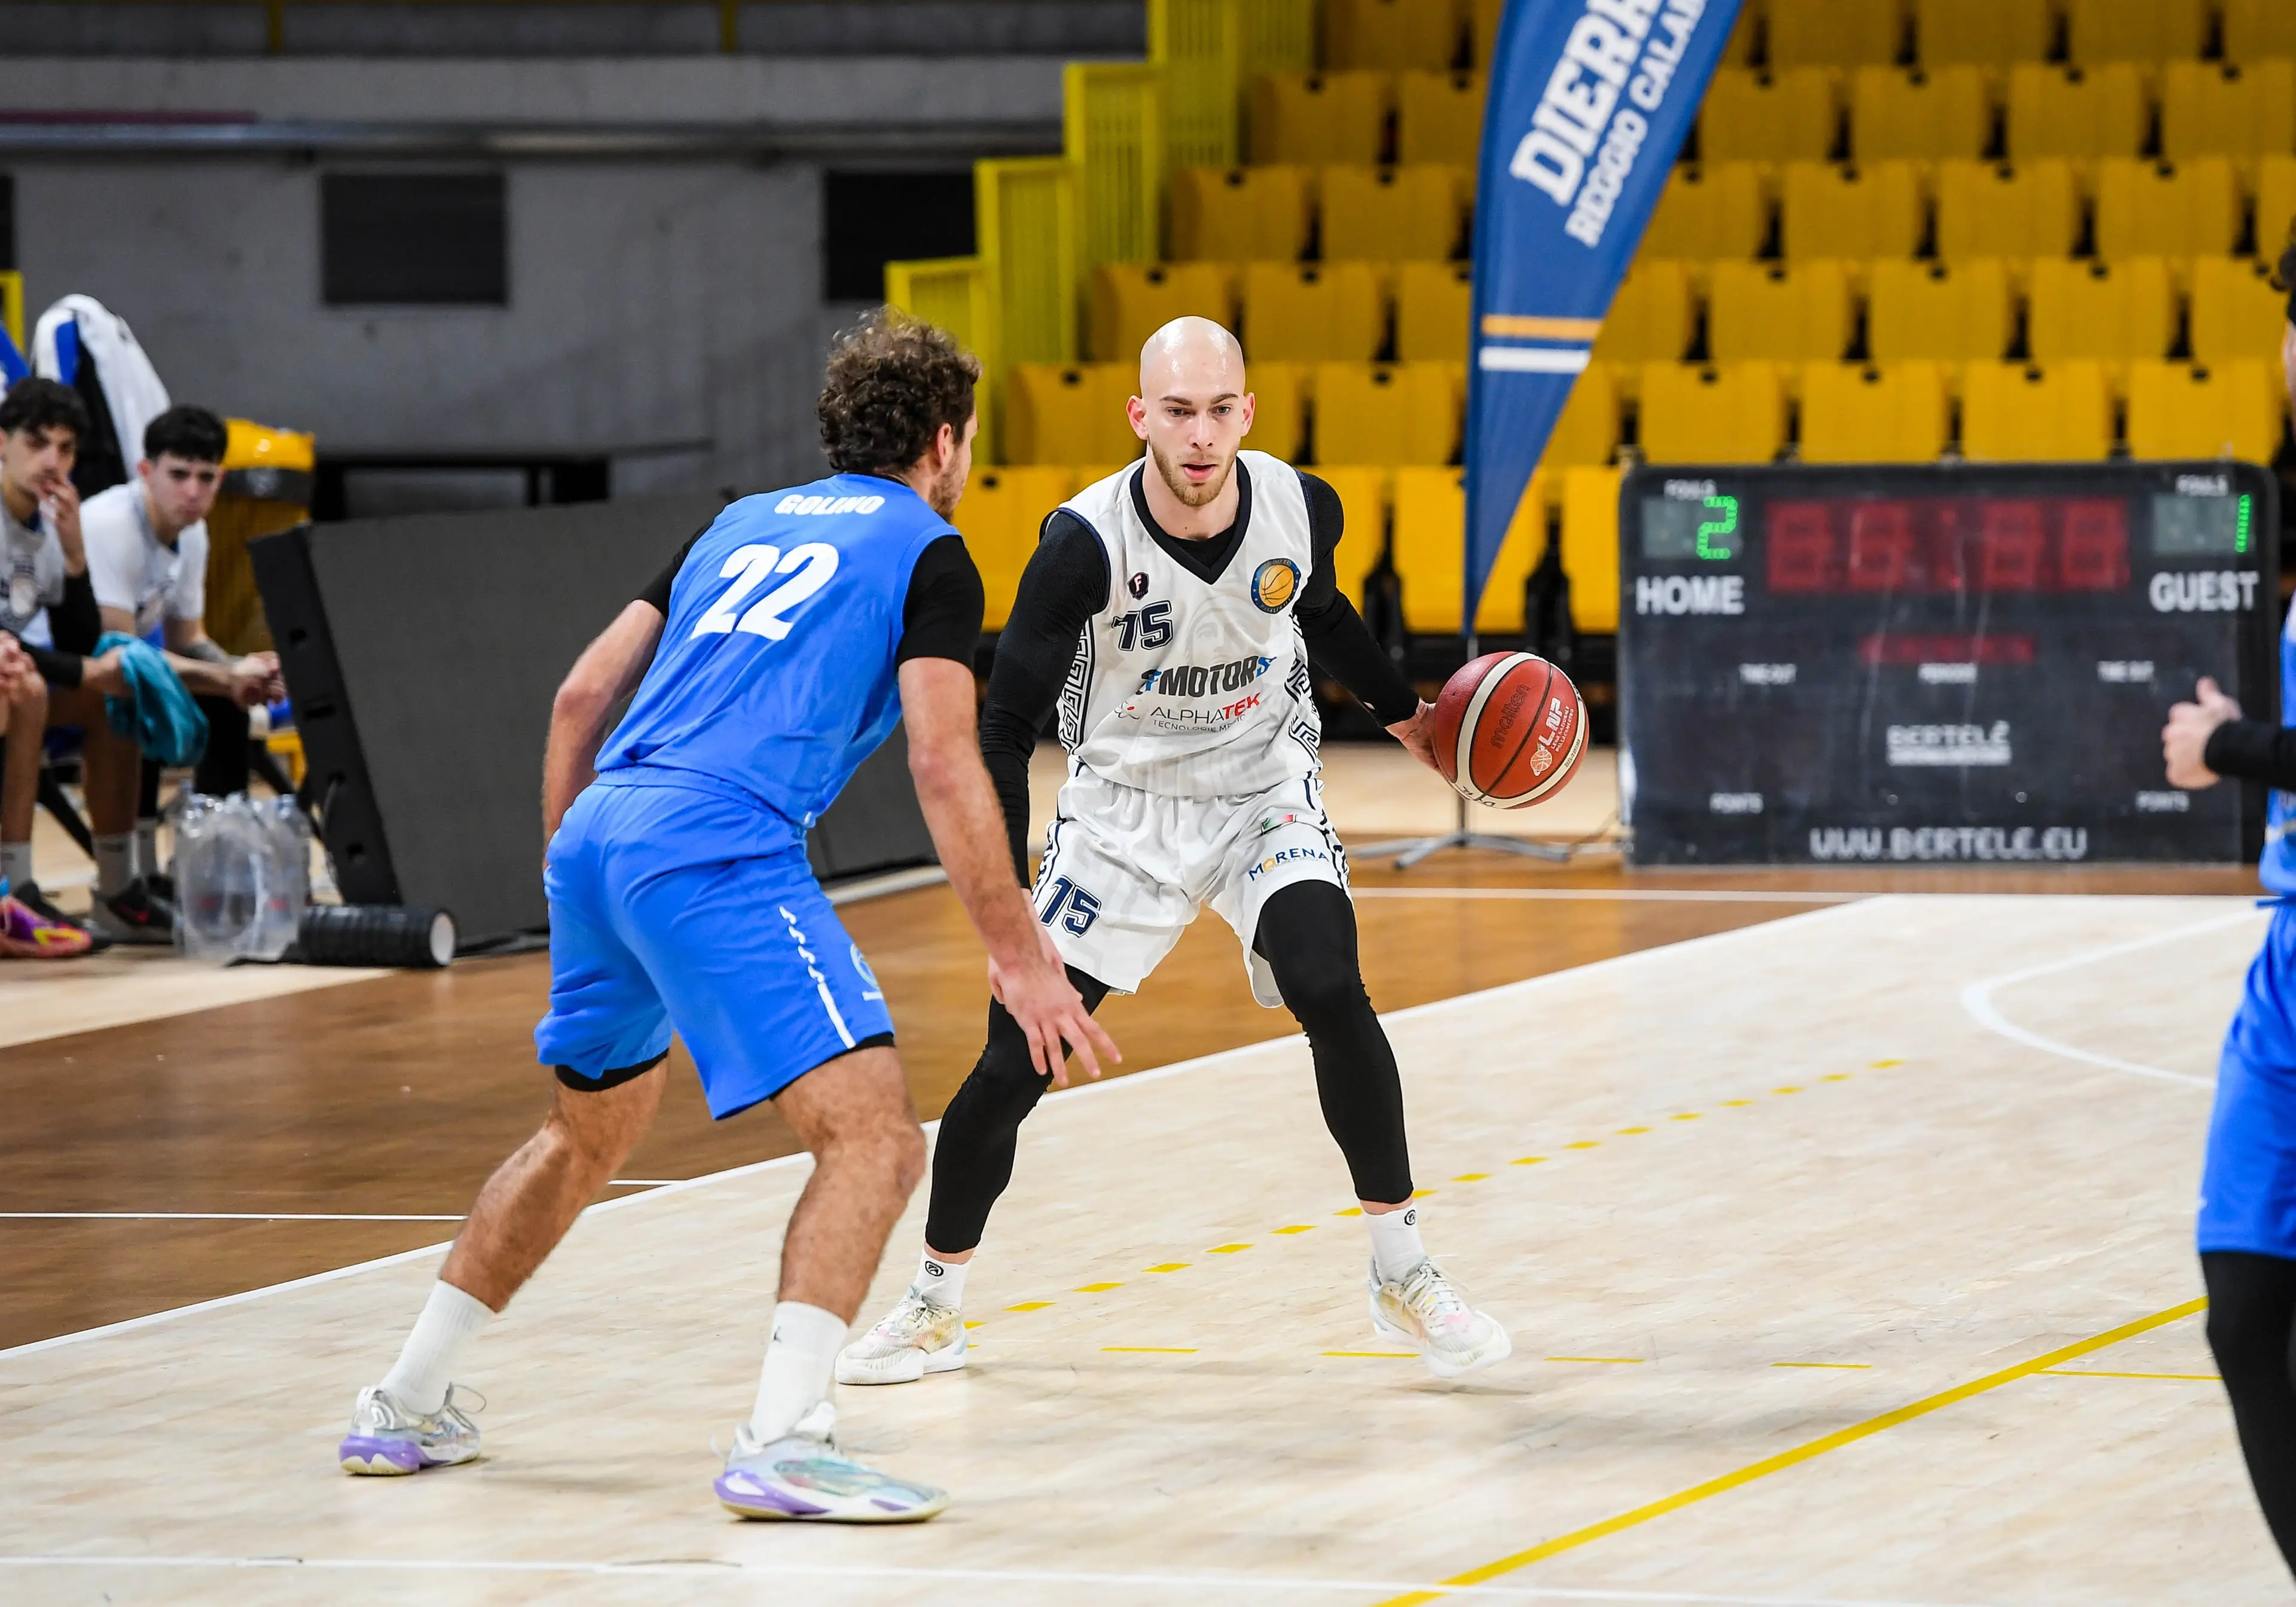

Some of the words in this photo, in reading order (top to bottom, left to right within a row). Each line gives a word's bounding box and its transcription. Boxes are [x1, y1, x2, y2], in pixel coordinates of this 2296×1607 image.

[1564, 108, 1648, 249] REGGIO
[774, 494, 885, 515] GOLINO
[1696, 496, 1738, 559] 2
[690, 542, 839, 641] 22
[1636, 575, 1745, 615] HOME
[2149, 570, 2260, 612] GUEST
[1112, 600, 1173, 651] 15
[1150, 692, 1260, 723] ALPHATEK
[1491, 685, 1531, 749] molten
[1538, 697, 1562, 746] LNP
[1039, 874, 1102, 938] 15
